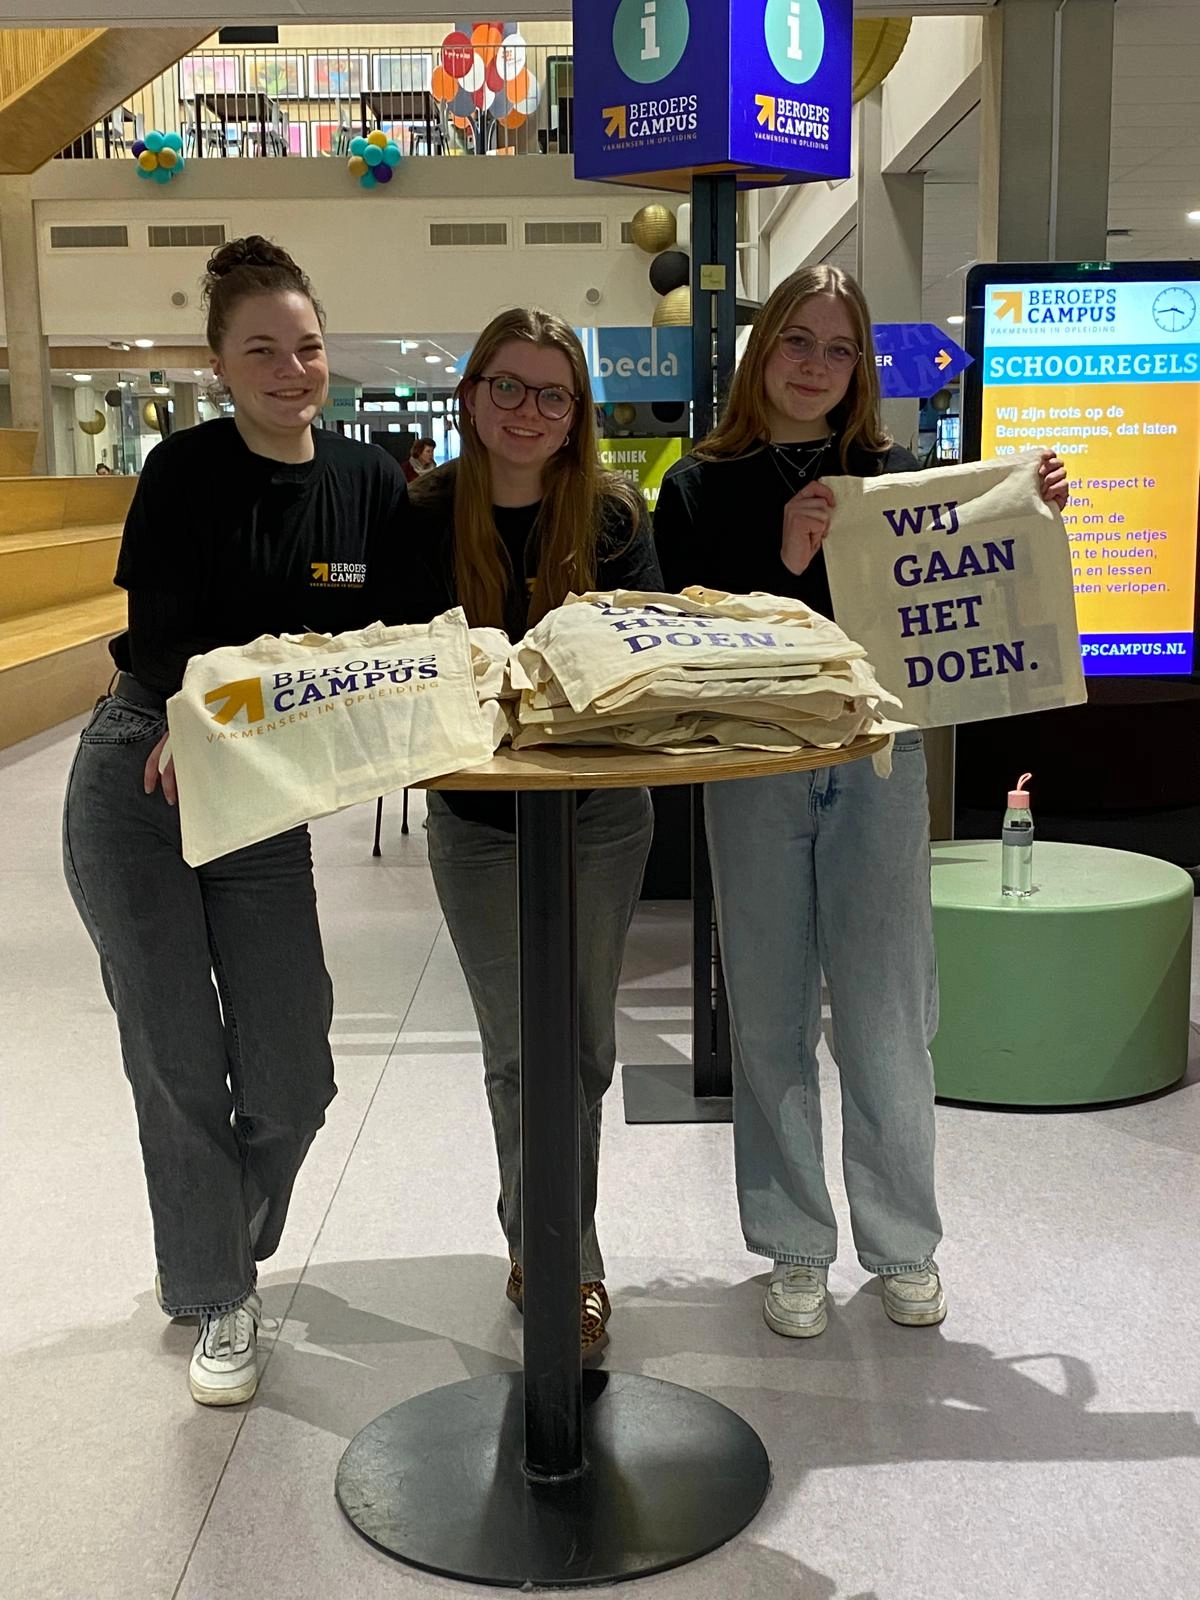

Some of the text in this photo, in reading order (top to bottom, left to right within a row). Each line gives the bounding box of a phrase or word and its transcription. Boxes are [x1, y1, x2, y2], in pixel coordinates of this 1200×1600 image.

[630, 95, 697, 120] BEROEPS
[777, 98, 829, 123] BEROEPS
[629, 113, 697, 137] CAMPUS
[776, 116, 829, 140] CAMPUS
[602, 140, 644, 151] VAKMENSEN
[658, 132, 697, 144] OPLEIDING
[754, 132, 789, 143] VAKMENSEN
[799, 139, 829, 150] OPLEIDING
[1029, 289, 1117, 305] BEROEPS
[1028, 306, 1116, 324] CAMPUS
[990, 327, 1046, 335] VAKMENSEN
[875, 355, 893, 366] ER
[989, 353, 1198, 378] SCHOOLREGELS
[996, 405, 1124, 422] Wij zijn trots op de
[996, 422, 1177, 439] Beroepscampus, dat laten
[597, 450, 647, 463] CHNIEK
[995, 445, 1015, 455] we
[1052, 441, 1089, 454] door:
[1067, 476, 1156, 492] et respect te
[883, 501, 959, 537] WIJ
[1062, 512, 1125, 524] en om de
[1068, 529, 1167, 543] campus netjes
[1072, 547, 1158, 559] n te houden,
[894, 539, 1015, 587] GAAN
[1073, 564, 1152, 576] n en lessen
[1073, 581, 1170, 595] aten verlopen.
[610, 618, 713, 632] HET
[898, 595, 982, 638] HET
[623, 632, 795, 654] DOEN.
[1081, 642, 1186, 656] PSCAMPUS.NL
[273, 653, 437, 690] BEROEPS
[904, 641, 1038, 688] DOEN.
[274, 663, 439, 712] CAMPUS
[205, 681, 440, 744] VAKMENSEN IN OPLEIDING
